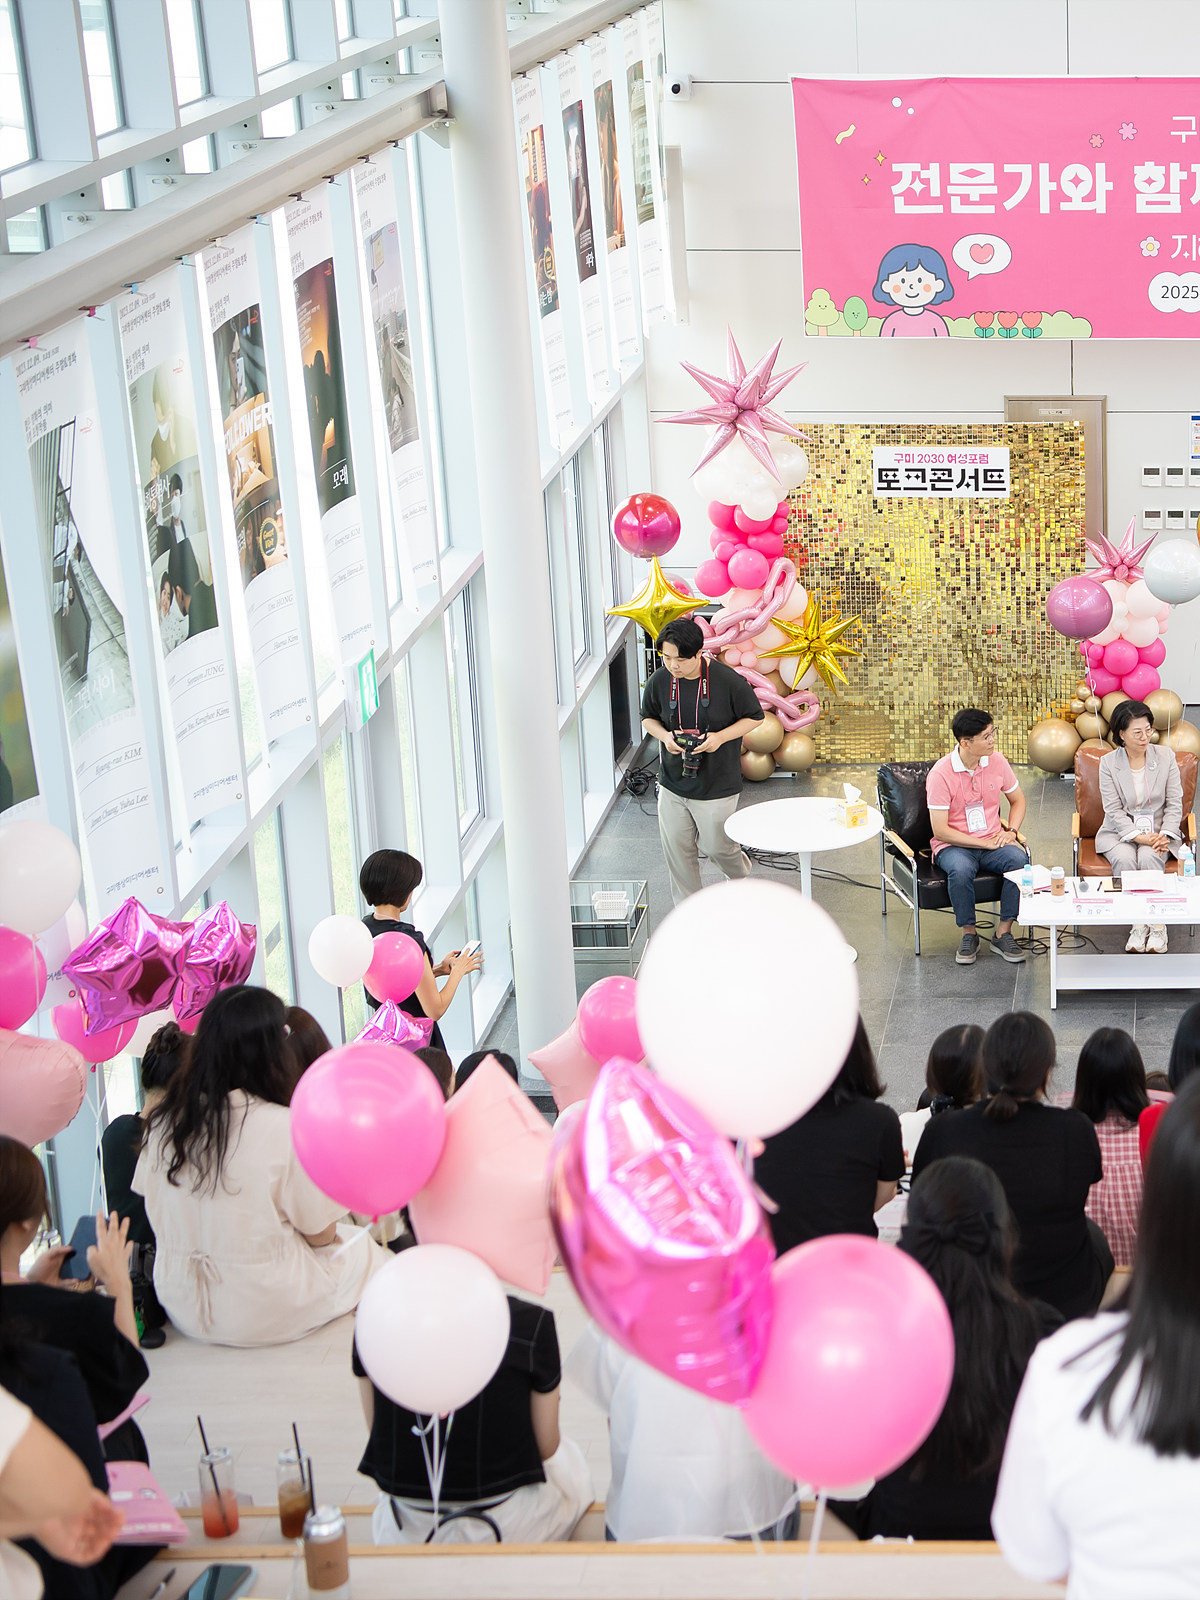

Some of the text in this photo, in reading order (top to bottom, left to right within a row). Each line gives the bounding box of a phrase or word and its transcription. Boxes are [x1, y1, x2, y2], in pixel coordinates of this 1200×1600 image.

[890, 162, 1113, 214] 전문가와
[894, 452, 989, 465] 구미 2030 여성포럼
[333, 464, 348, 489] 모래
[876, 468, 1006, 492] 토크콘서트
